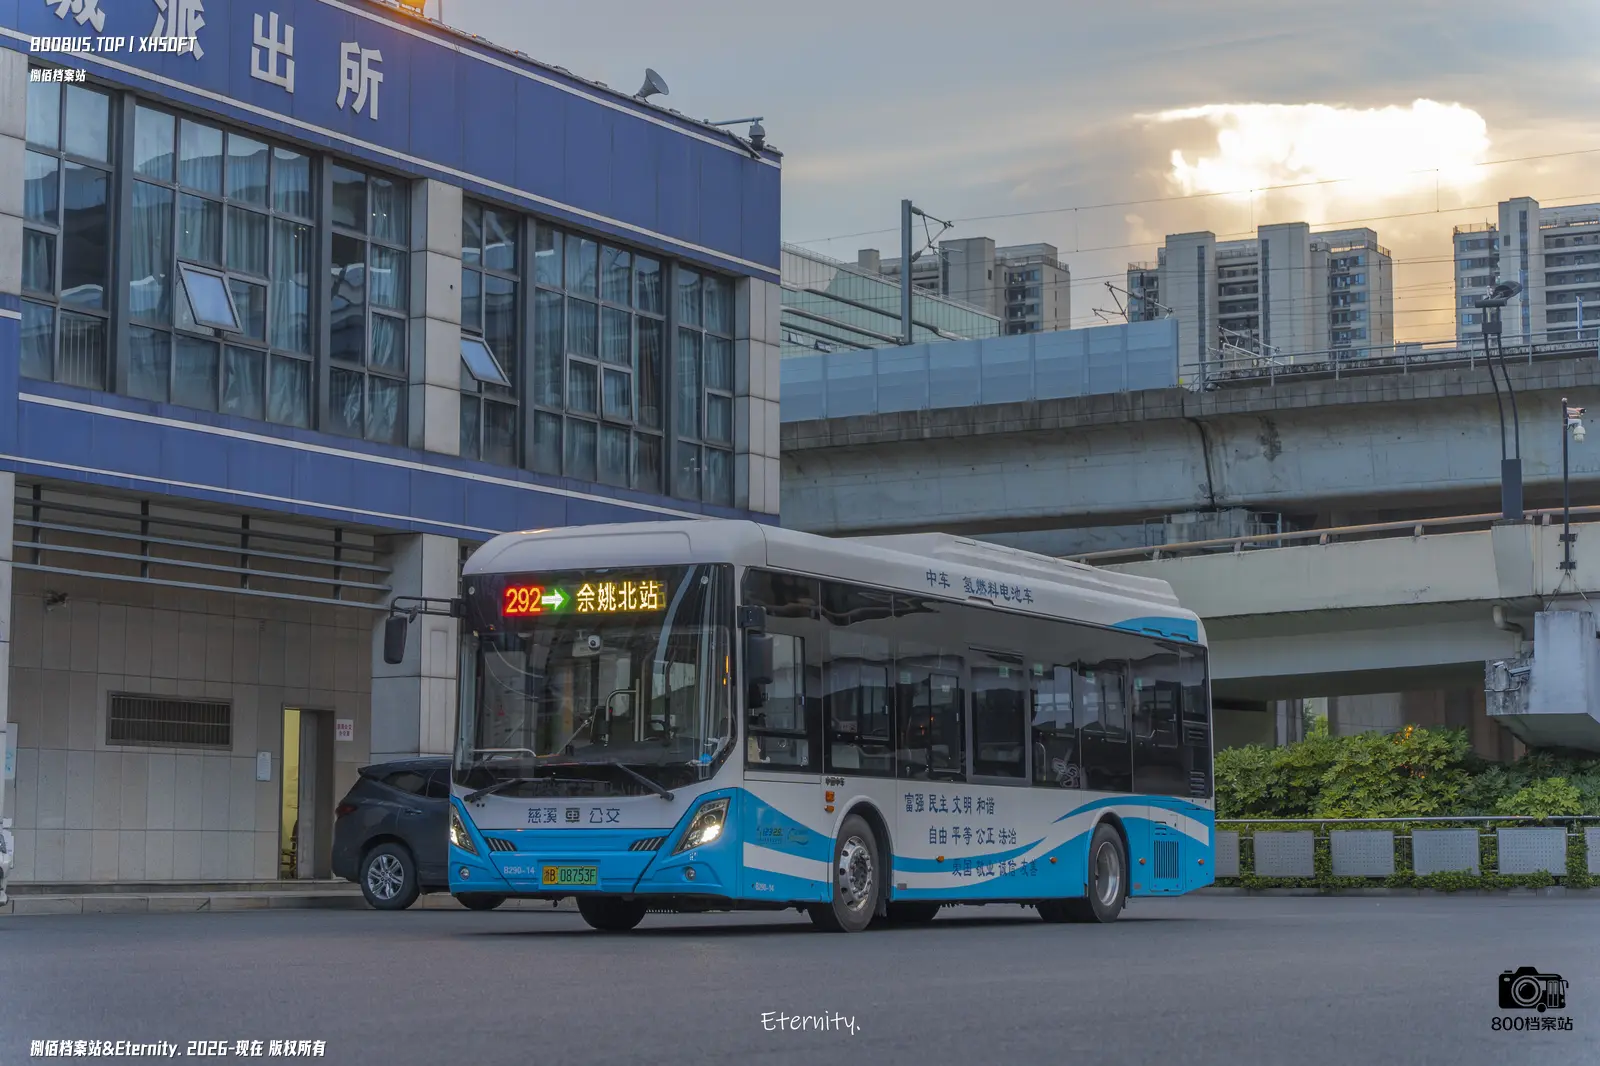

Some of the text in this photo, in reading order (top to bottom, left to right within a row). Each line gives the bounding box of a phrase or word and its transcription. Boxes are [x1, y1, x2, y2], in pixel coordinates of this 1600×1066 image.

[576, 580, 659, 612] 余姚北站
[926, 569, 1034, 605] 中车 氢燃料电池车
[505, 587, 541, 613] 292
[904, 792, 995, 815] 富强 民主 文明 和谐
[527, 807, 621, 824] 慈溪 公交
[929, 825, 1017, 845] 自由 平等 公正 法治
[503, 866, 535, 875] B290-14
[976, 859, 995, 877] 敬业
[998, 860, 1017, 877] 诚信
[1020, 858, 1039, 877] 友善
